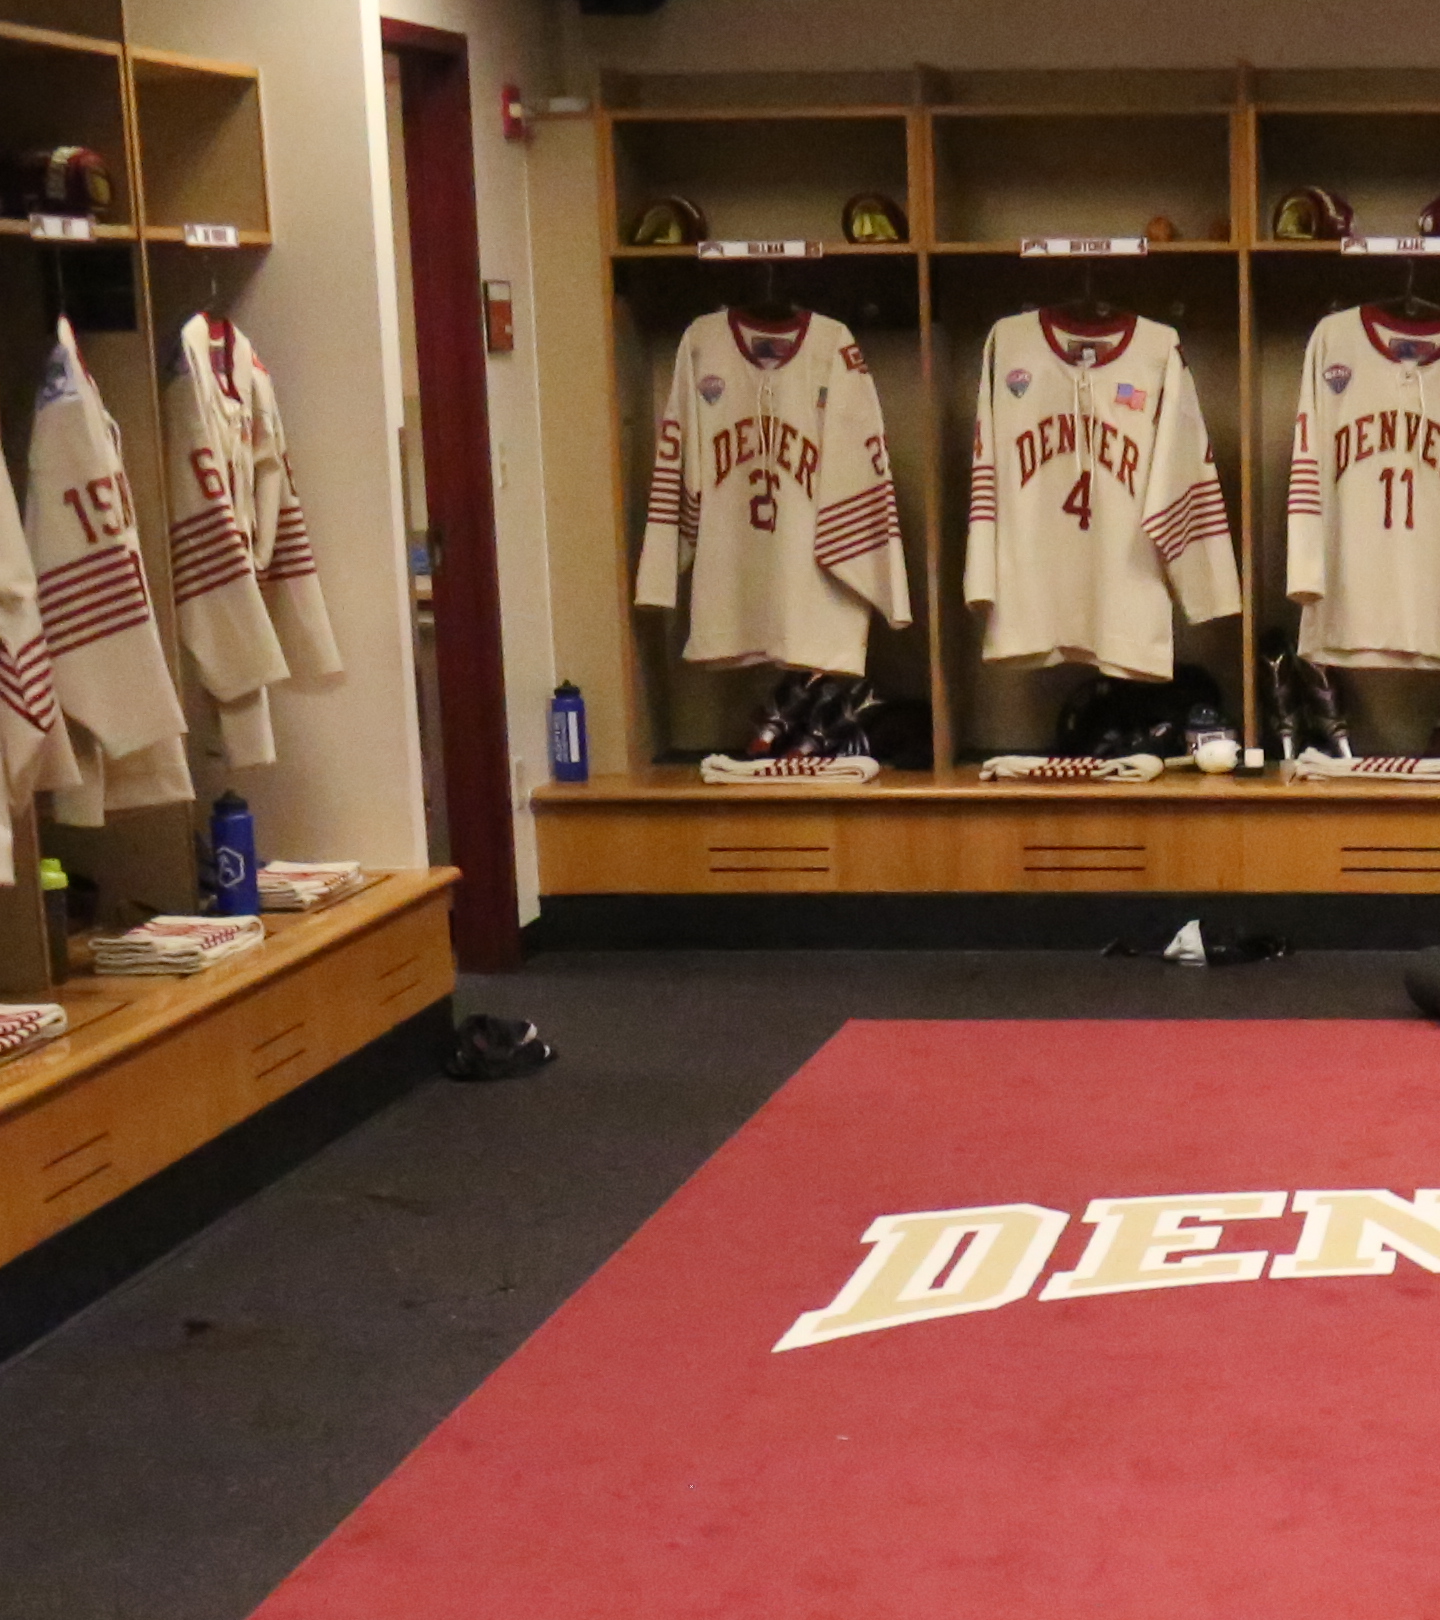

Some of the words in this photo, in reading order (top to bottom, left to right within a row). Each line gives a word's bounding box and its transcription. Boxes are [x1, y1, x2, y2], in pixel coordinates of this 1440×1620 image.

[659, 418, 682, 462] 5
[1016, 412, 1140, 498] DENVER
[1296, 412, 1309, 453] 1
[191, 447, 226, 500] 6
[1062, 469, 1092, 531] 4
[1379, 466, 1415, 530] 11
